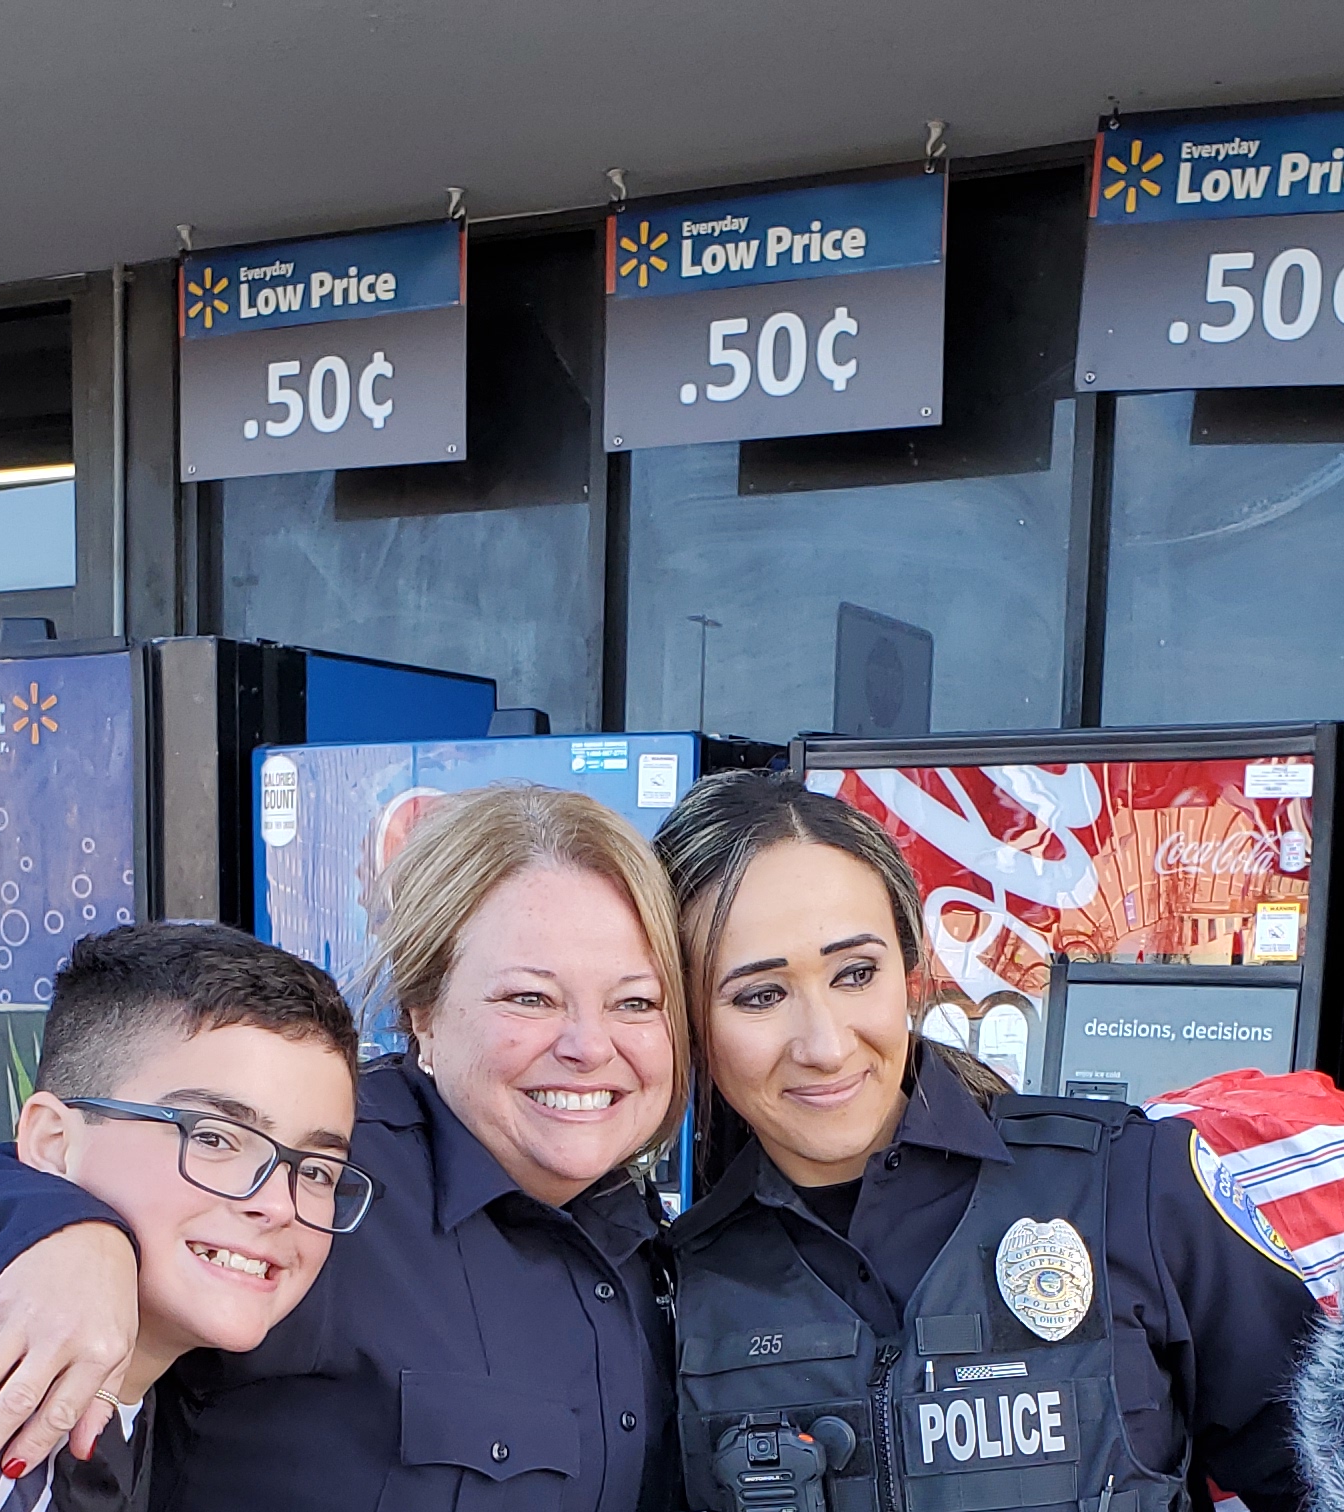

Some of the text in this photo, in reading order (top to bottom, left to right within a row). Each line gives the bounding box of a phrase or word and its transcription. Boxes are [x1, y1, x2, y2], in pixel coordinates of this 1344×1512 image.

[1180, 138, 1260, 160] Everyday
[1175, 161, 1270, 204] Low
[681, 214, 749, 237] Everyday
[680, 220, 866, 277] Low Price
[239, 260, 294, 282] Everyday
[239, 266, 397, 319] Low Price
[679, 306, 858, 405] .50¢
[243, 351, 394, 440] .50¢
[264, 788, 295, 810] COUNT
[1154, 830, 1278, 876] Coca-Cola
[1084, 1018, 1273, 1042] decisions, decisions
[1039, 1315, 1065, 1324] OHIO
[748, 1334, 784, 1356] 255
[918, 1391, 1066, 1464] POLICE
